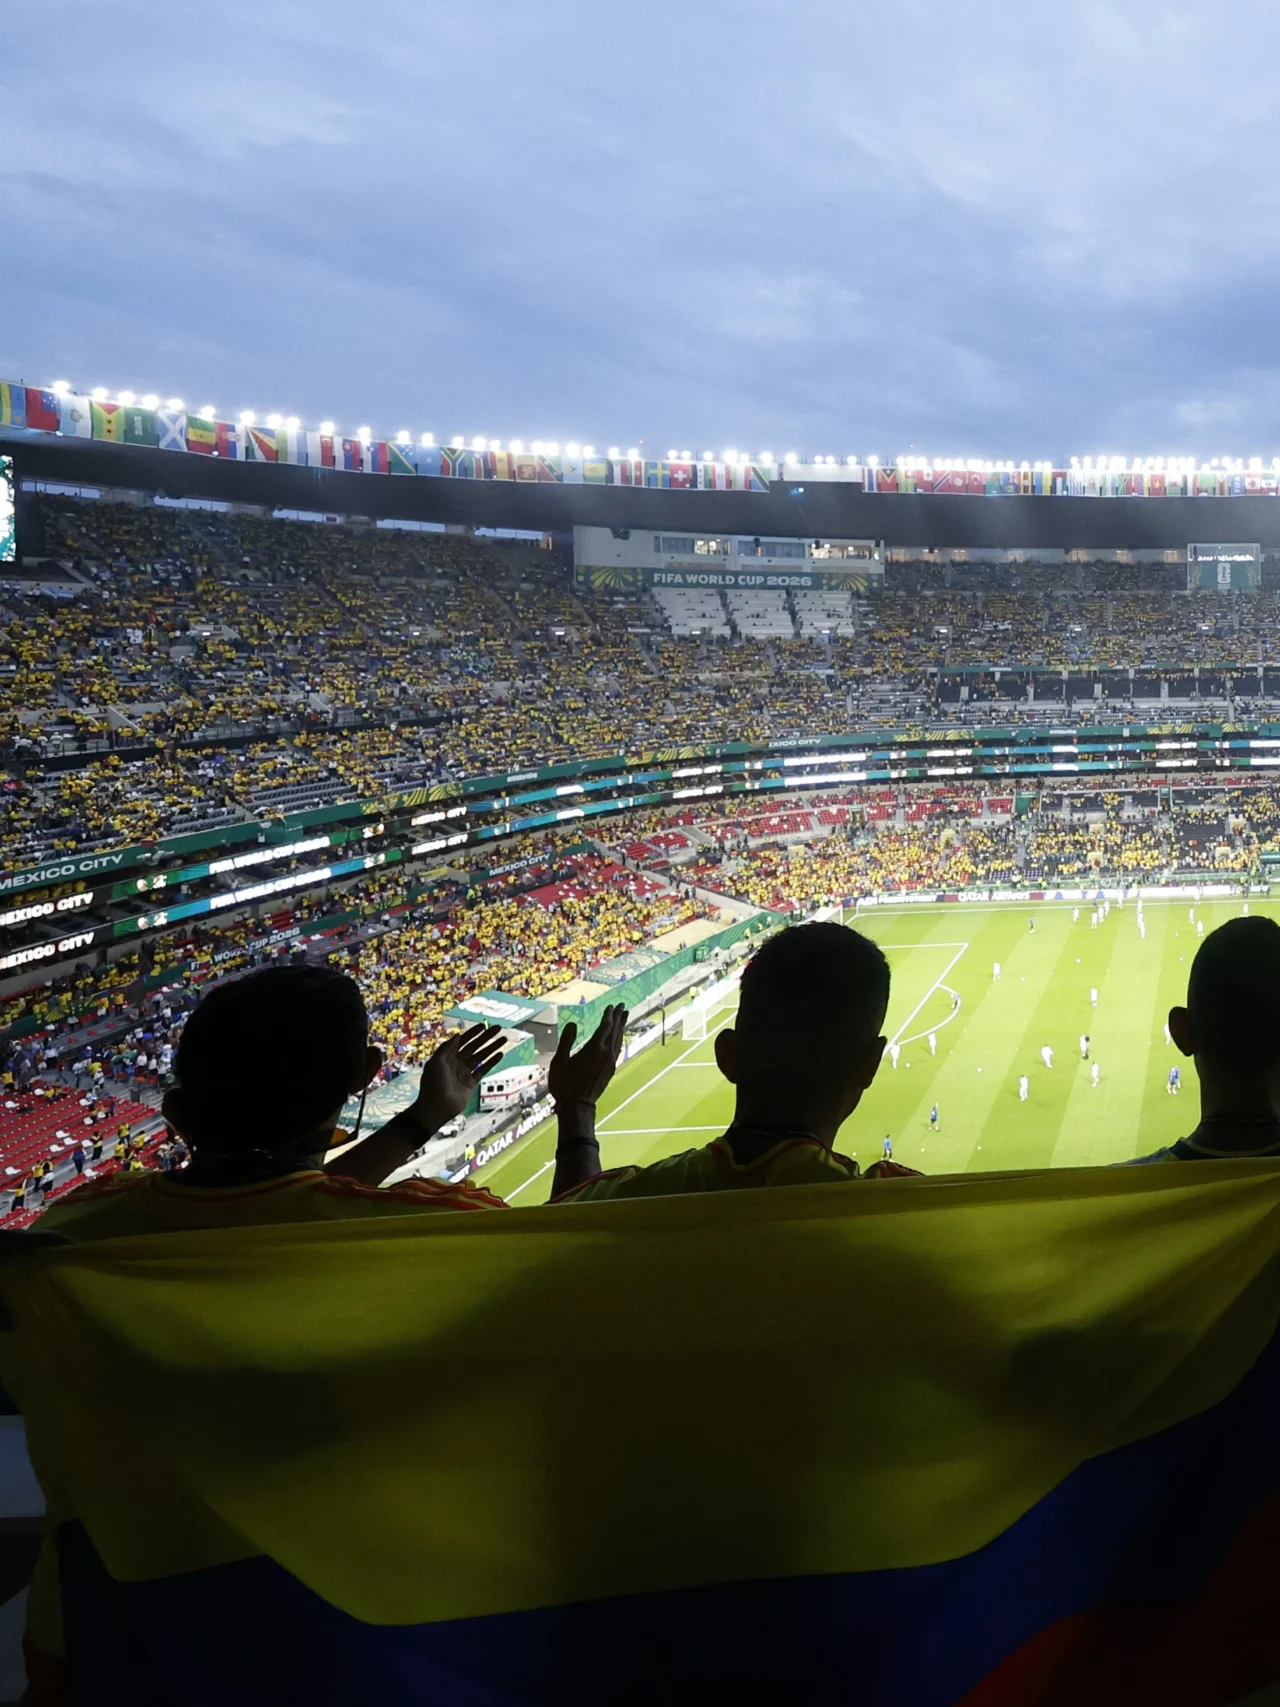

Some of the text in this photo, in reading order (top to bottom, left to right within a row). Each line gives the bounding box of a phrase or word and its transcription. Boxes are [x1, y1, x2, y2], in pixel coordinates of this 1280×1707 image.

[653, 573, 812, 586] FIFA WORLD CUP 2026
[79, 853, 123, 872] CITY
[489, 853, 550, 876] MEXICO CITY
[56, 892, 94, 911] CITY
[958, 891, 989, 902] QATAR
[58, 932, 95, 952] CITY
[269, 927, 300, 944] 2026
[476, 1130, 514, 1167] QATAR
